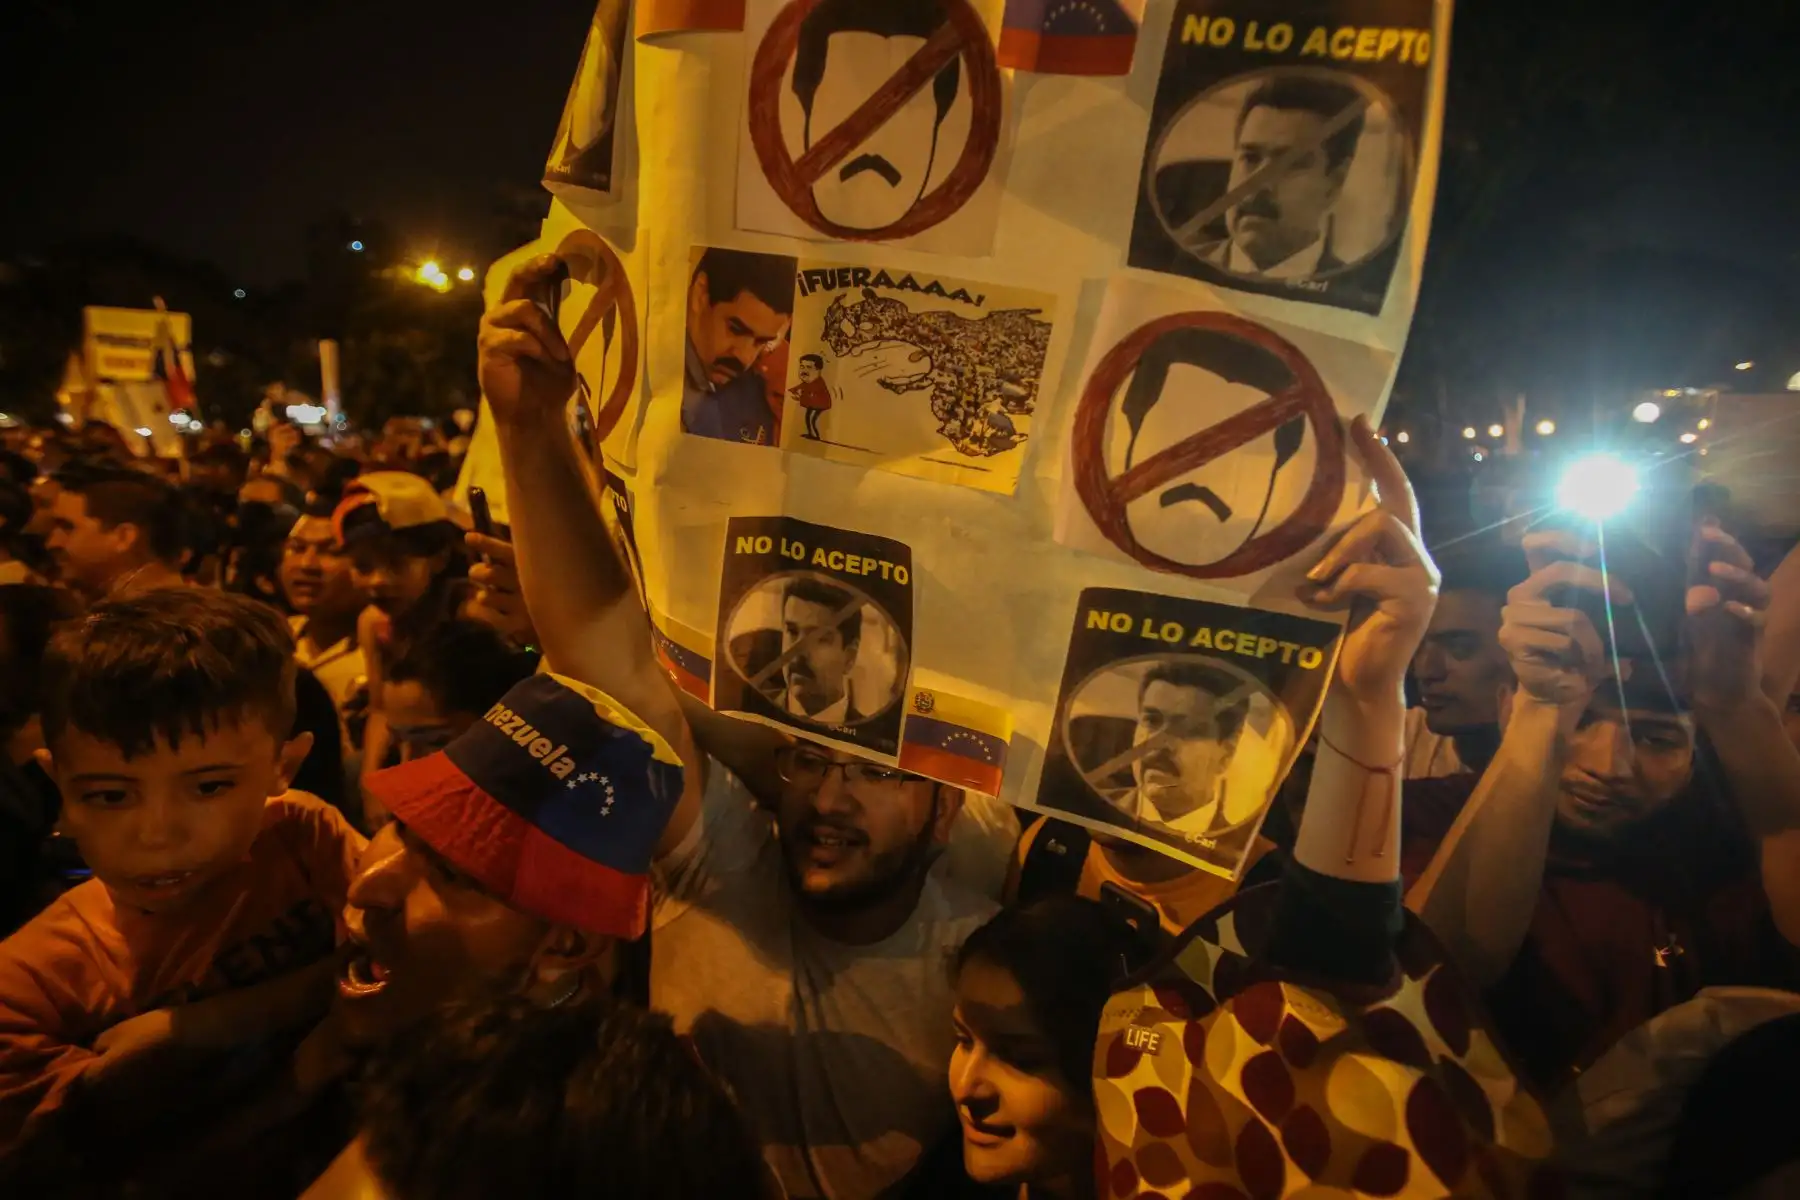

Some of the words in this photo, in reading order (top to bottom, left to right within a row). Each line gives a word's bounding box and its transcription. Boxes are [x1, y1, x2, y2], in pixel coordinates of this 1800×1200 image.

[1181, 14, 1235, 46] NO
[1243, 21, 1293, 52] LO
[1300, 27, 1431, 64] ACEPTO
[736, 536, 772, 555] NO
[780, 537, 806, 561] LO
[811, 547, 909, 586] ACEPTO
[1086, 610, 1133, 634] NO
[1140, 618, 1184, 643] LO
[1188, 627, 1323, 670] ACEPTO
[1126, 1028, 1160, 1051] LIFE
